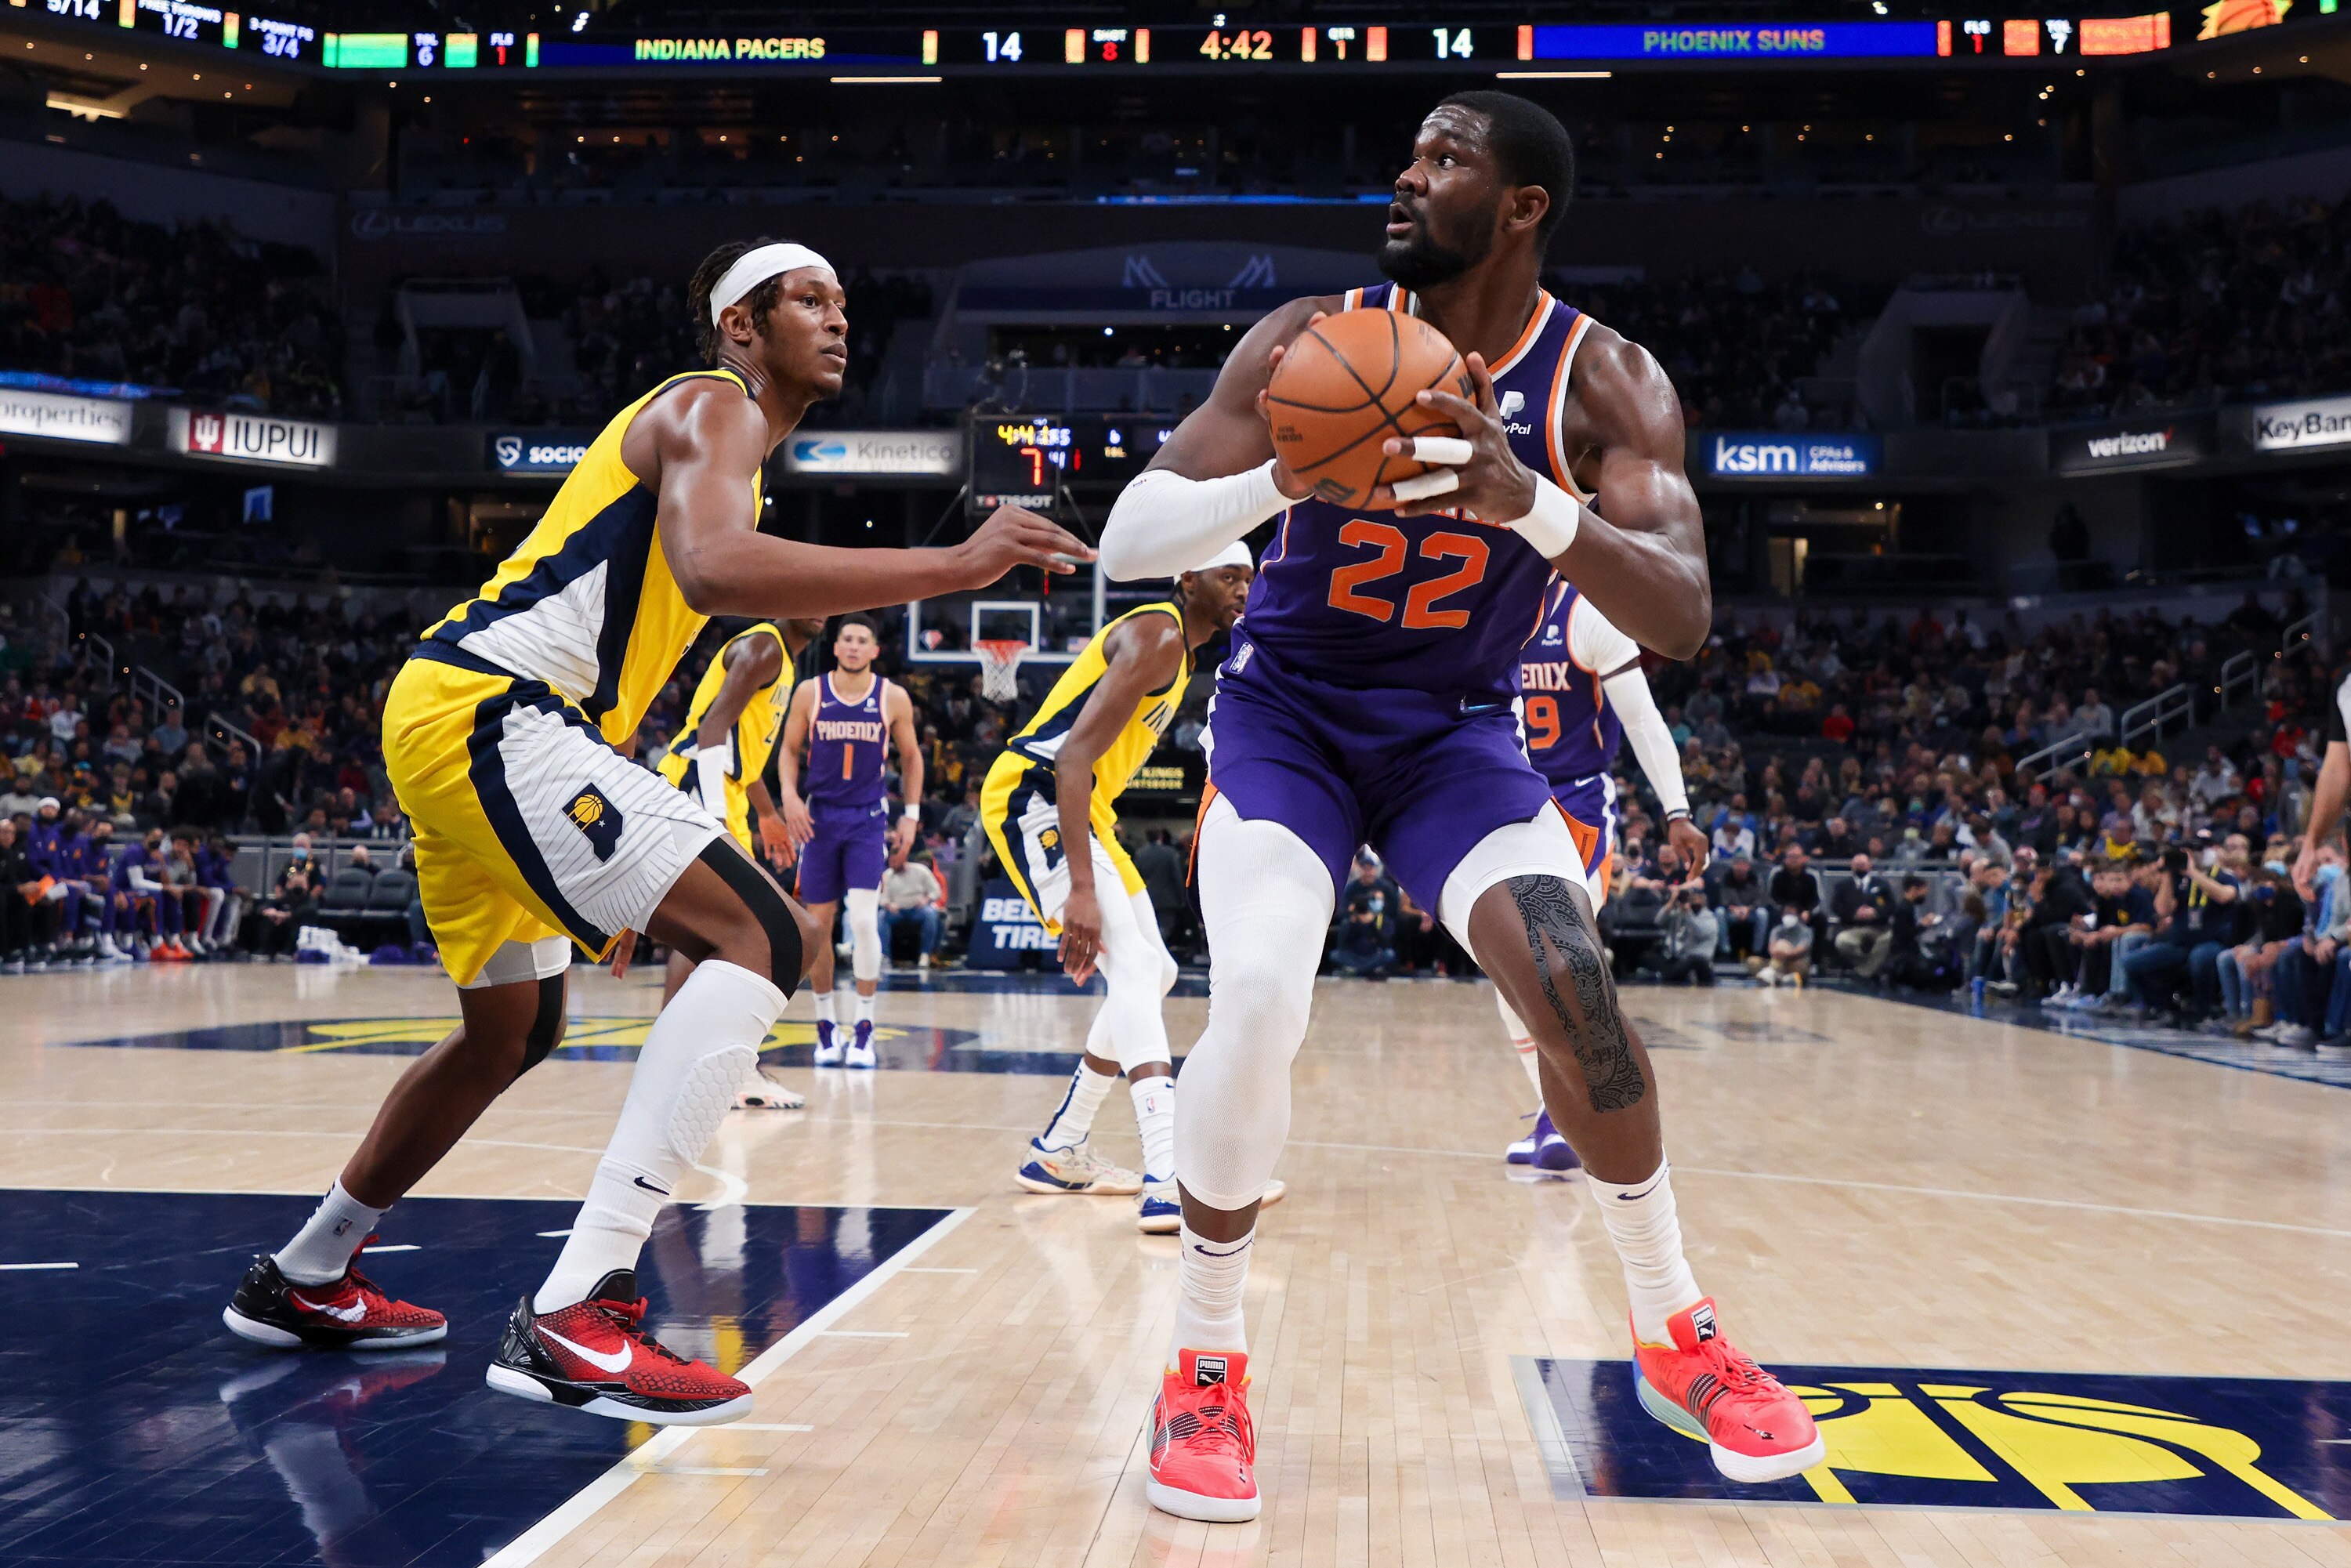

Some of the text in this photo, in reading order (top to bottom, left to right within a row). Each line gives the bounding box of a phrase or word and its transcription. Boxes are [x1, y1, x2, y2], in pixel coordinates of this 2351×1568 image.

[162, 13, 198, 39] 1/2
[263, 33, 299, 59] 3/4
[635, 38, 825, 60] INDIANA PACERS
[983, 32, 1022, 61] 14
[1103, 42, 1118, 60] 8
[1200, 30, 1273, 60] 4:42
[1335, 39, 1346, 60] 1
[1433, 27, 1473, 59] 14
[1643, 29, 1825, 52] PHOENIX SUNS
[1972, 34, 1983, 53] 1
[2051, 32, 2068, 54] 7
[418, 45, 433, 66] 6
[497, 45, 506, 65] 1
[1150, 289, 1236, 310] FLIGHT
[234, 421, 317, 458] IUPUI
[857, 440, 951, 462] Kinetico
[2087, 432, 2166, 458] verizon
[1716, 436, 1797, 472] ksm
[1020, 447, 1043, 486] 7
[997, 494, 1054, 508] TISSOT
[1328, 518, 1490, 628] 22
[816, 720, 883, 743] PHOENIX
[1525, 695, 1561, 750] 9
[842, 743, 854, 780] 1
[1199, 1360, 1224, 1370] PUMA
